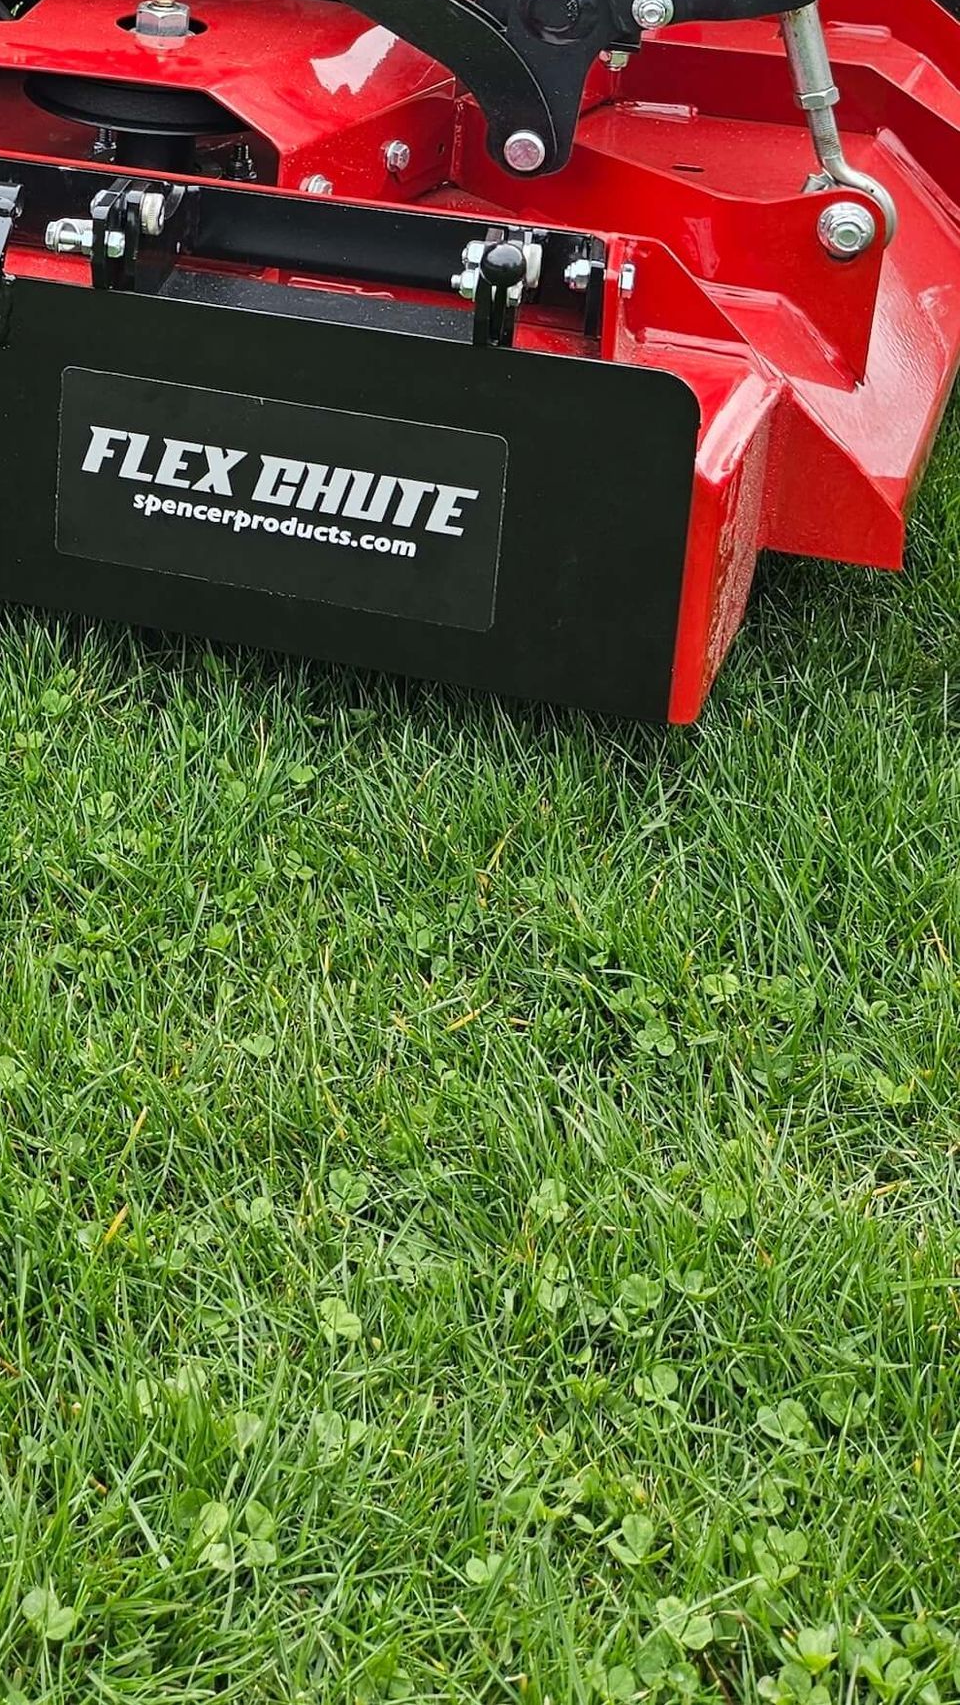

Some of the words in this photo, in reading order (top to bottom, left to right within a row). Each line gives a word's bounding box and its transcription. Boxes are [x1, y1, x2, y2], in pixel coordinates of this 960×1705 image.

[81, 425, 249, 496] FLEX
[251, 454, 480, 536] CHUTE
[133, 492, 417, 558] spencerproducts.com
